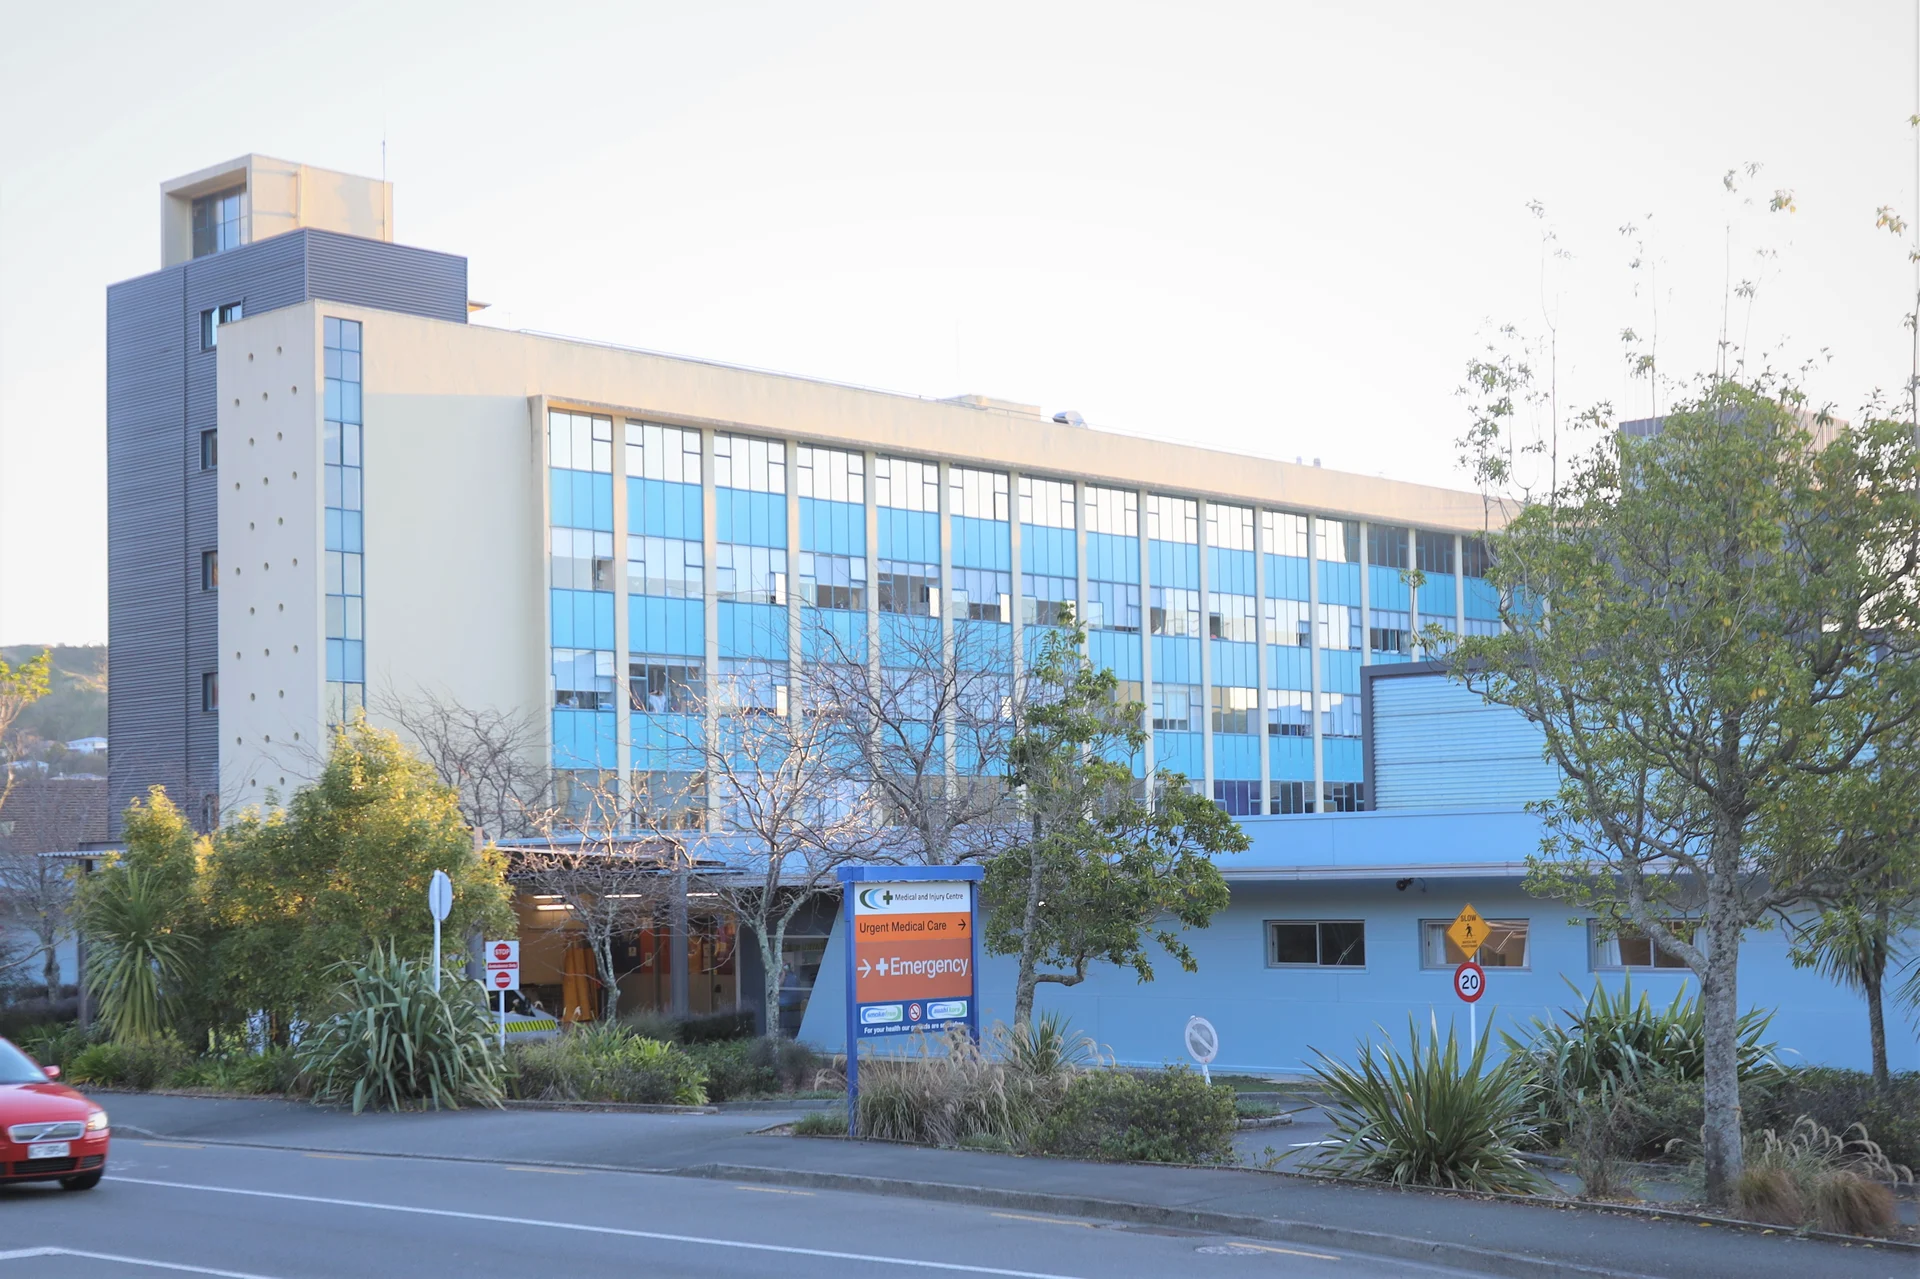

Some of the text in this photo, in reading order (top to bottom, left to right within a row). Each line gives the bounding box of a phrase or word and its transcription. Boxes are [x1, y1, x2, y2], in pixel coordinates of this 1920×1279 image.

[895, 893, 917, 901] Medical
[930, 893, 944, 901] Injury
[859, 920, 947, 936] Urgent Medical Care
[890, 957, 968, 979] Emergency
[1462, 975, 1478, 989] 20
[864, 1026, 873, 1034] For
[873, 1027, 885, 1035] your
